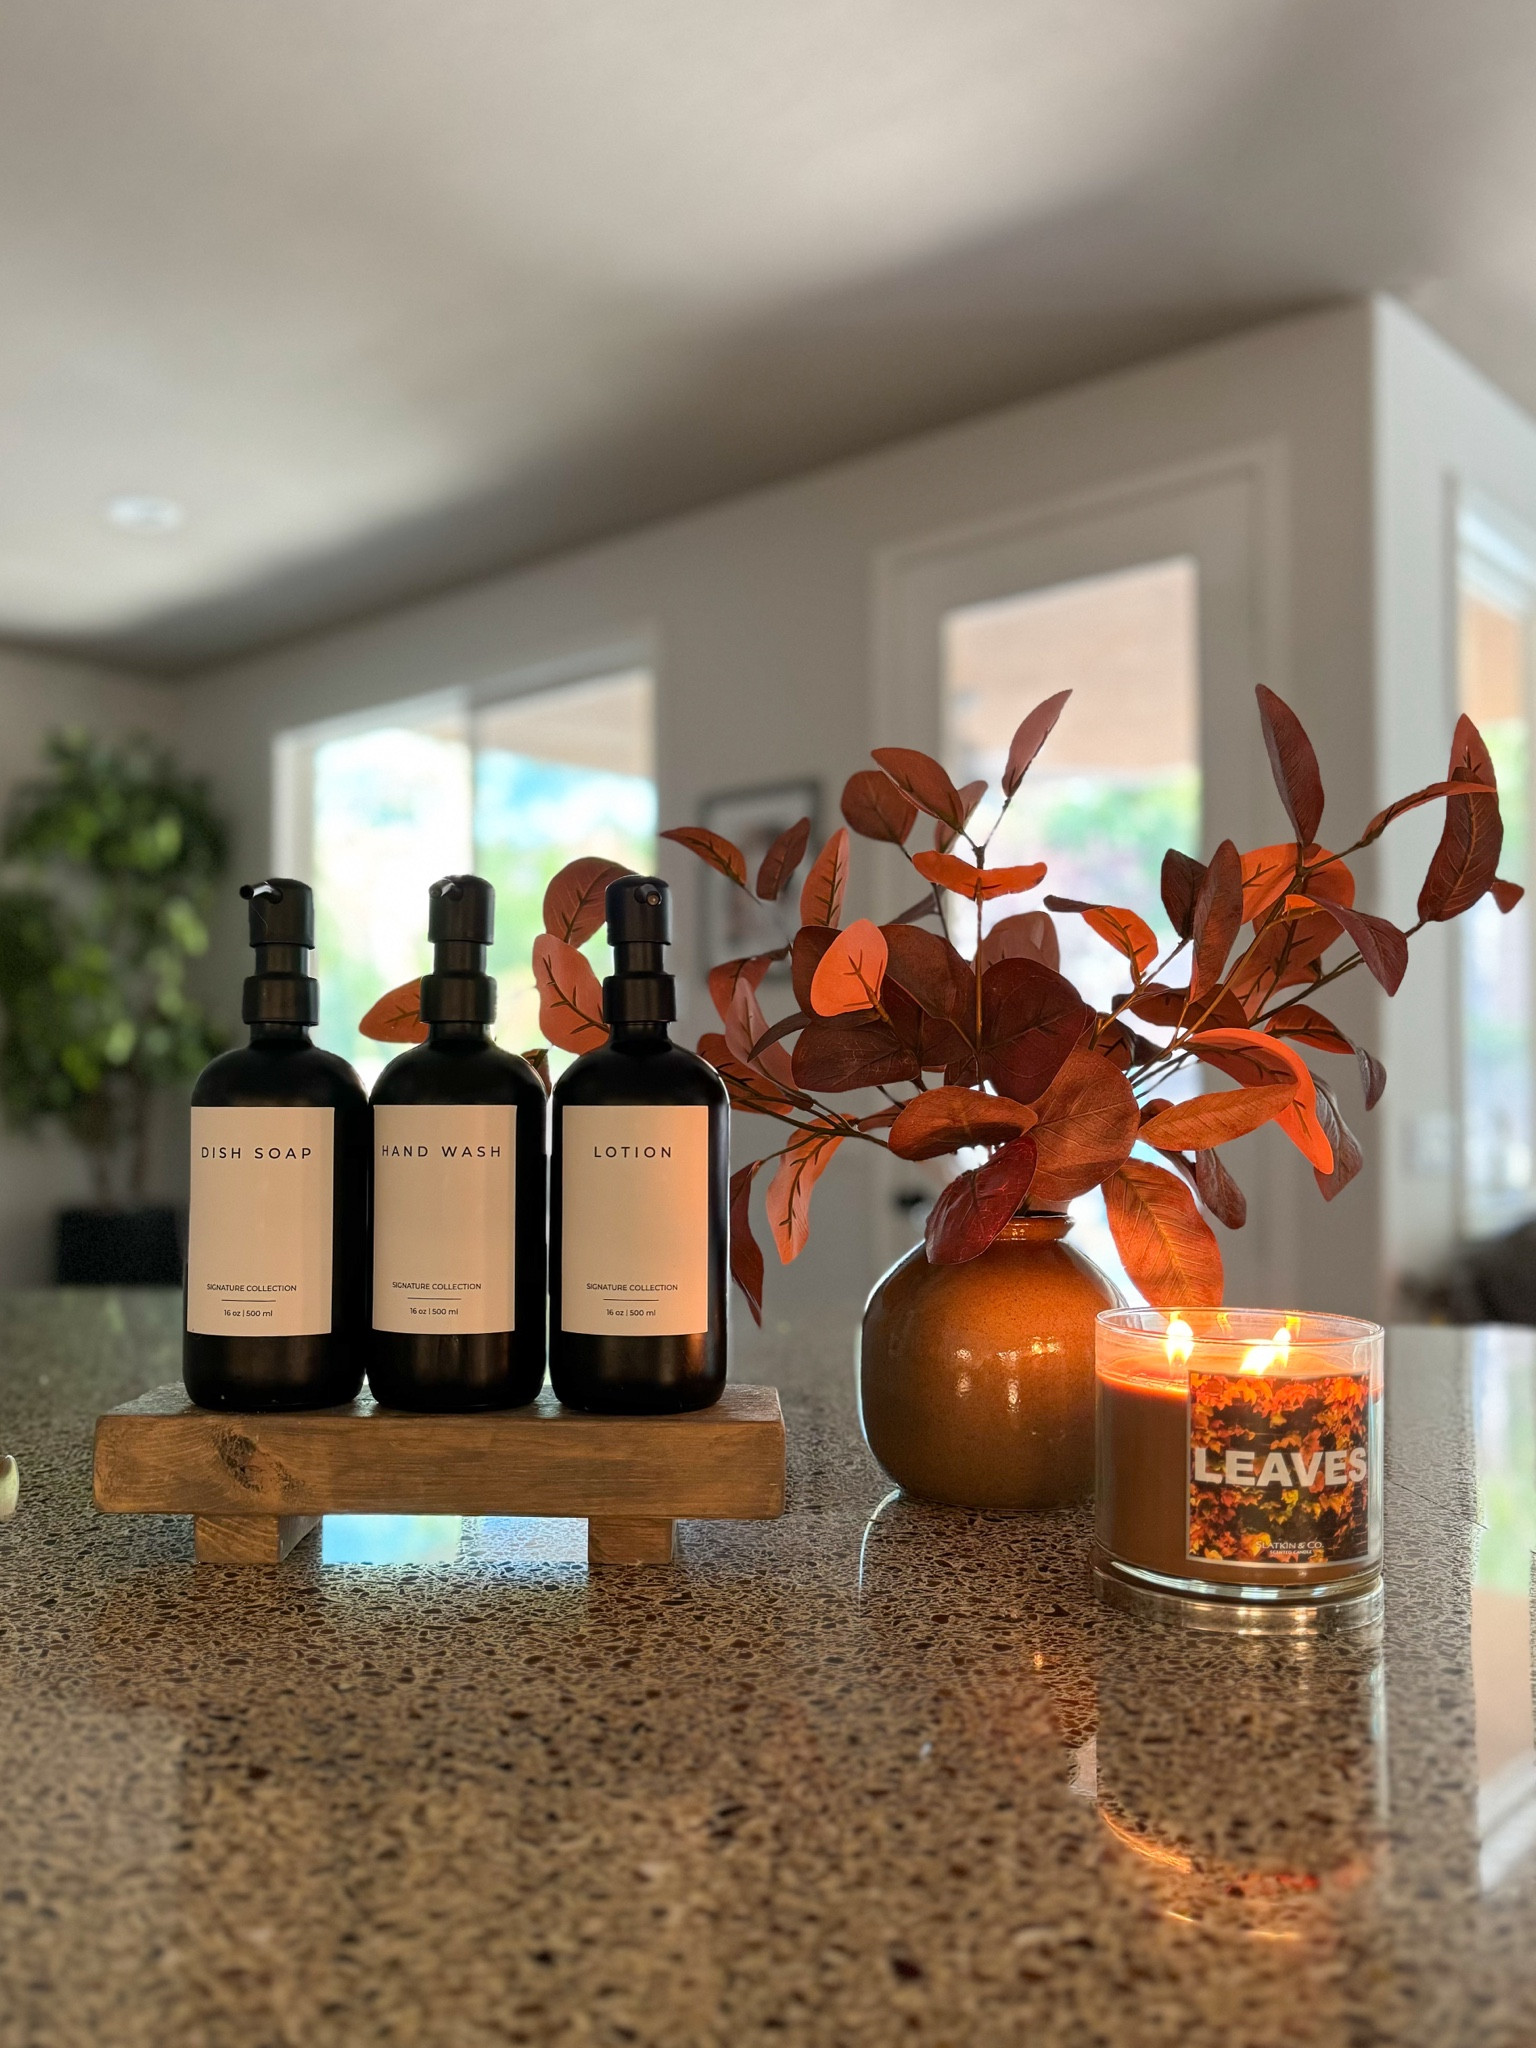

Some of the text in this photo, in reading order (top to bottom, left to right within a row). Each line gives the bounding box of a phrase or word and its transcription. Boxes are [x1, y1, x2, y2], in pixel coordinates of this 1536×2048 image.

[201, 1146, 312, 1160] DISH SOAP
[381, 1144, 501, 1158] HAND WASH
[593, 1145, 672, 1159] LOTION
[206, 1283, 297, 1292] SIGNATURE COLLECTION
[392, 1281, 482, 1291] SIGNATURE COLLECTION
[586, 1282, 679, 1292] SIGNATURE COLLECTION
[223, 1309, 231, 1317] 16
[409, 1307, 417, 1315] 16
[432, 1308, 447, 1316] 500
[448, 1308, 459, 1316] ml
[606, 1308, 614, 1316] 16
[629, 1309, 645, 1317] 500
[646, 1309, 656, 1317] ml
[1194, 1447, 1367, 1488] LEAVES
[1255, 1540, 1325, 1550] SLATKIN & CO.
